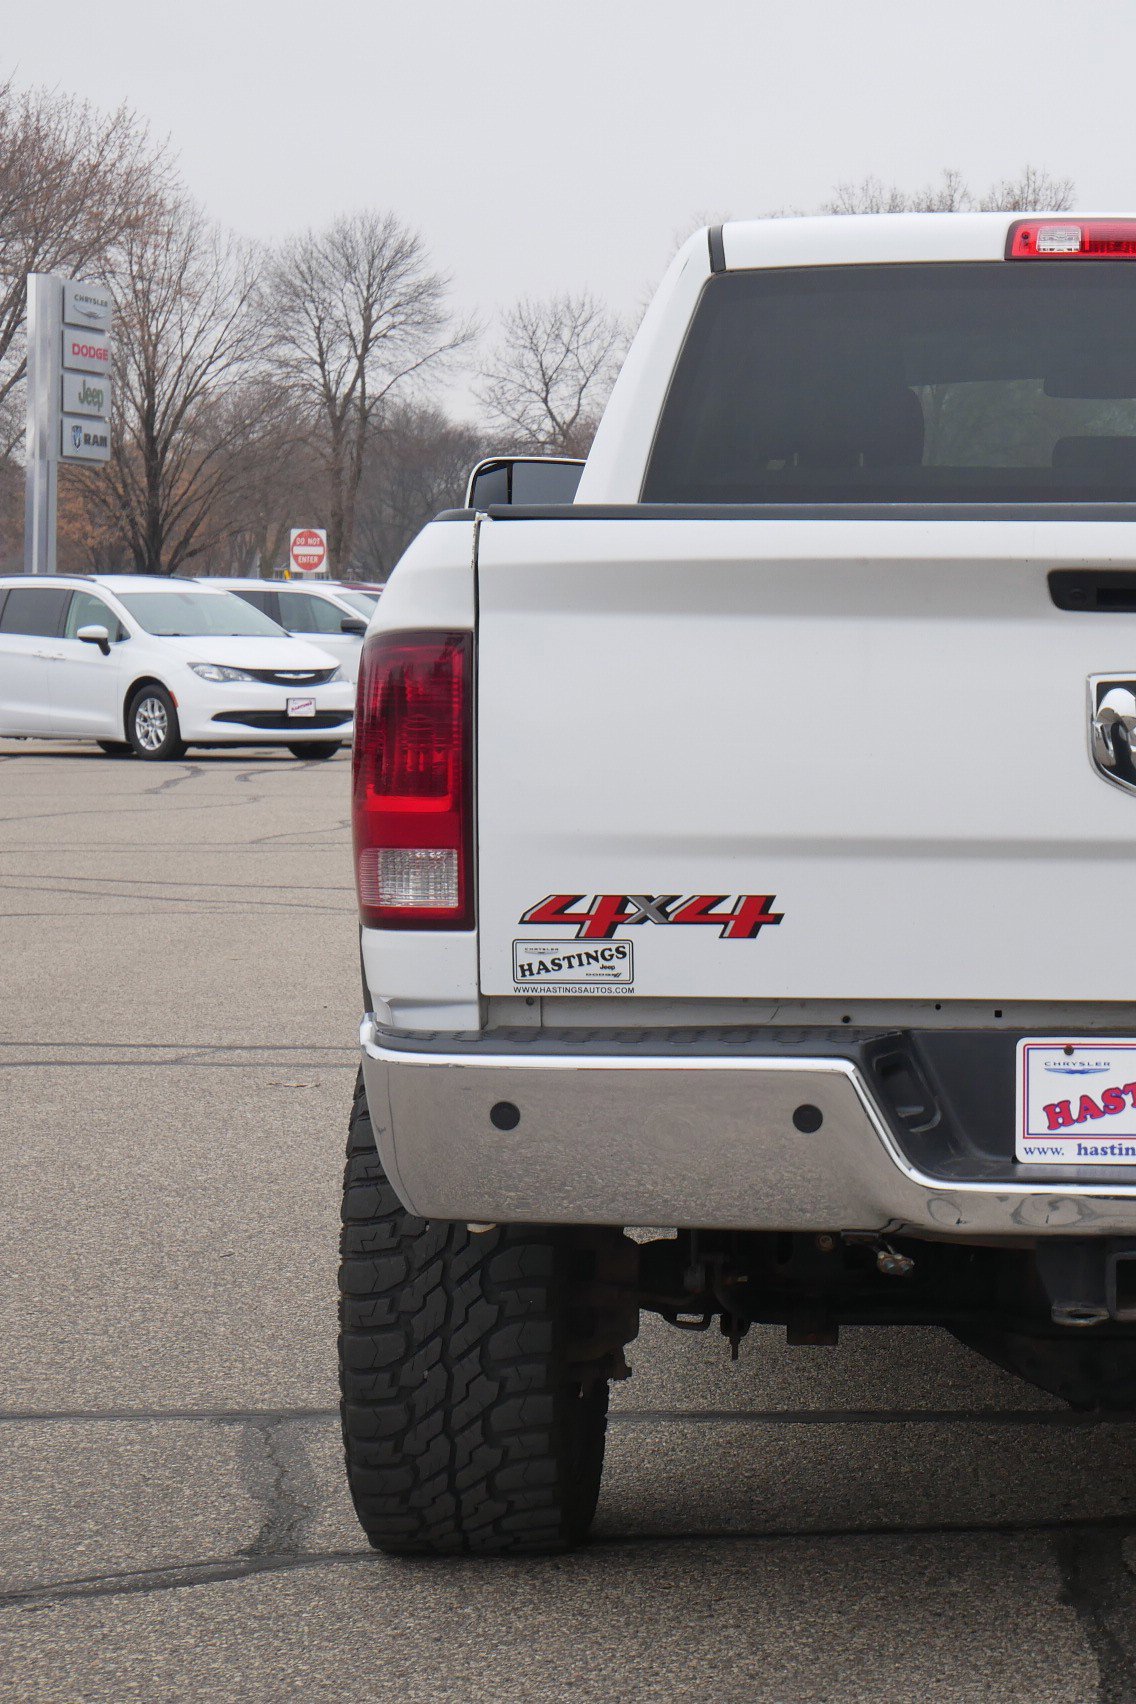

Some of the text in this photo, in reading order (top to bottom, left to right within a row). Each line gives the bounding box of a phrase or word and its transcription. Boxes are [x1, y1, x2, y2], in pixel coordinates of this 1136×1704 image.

[74, 293, 108, 307] CHRYSLER
[72, 343, 108, 361] DODGE
[78, 379, 104, 412] Jeep
[84, 433, 107, 447] RAM
[308, 537, 320, 545] NOT
[518, 945, 628, 978] HASTINGS
[513, 986, 635, 994] WWW.HASTINGSAUTOS.COM
[1024, 1147, 1065, 1156] www.
